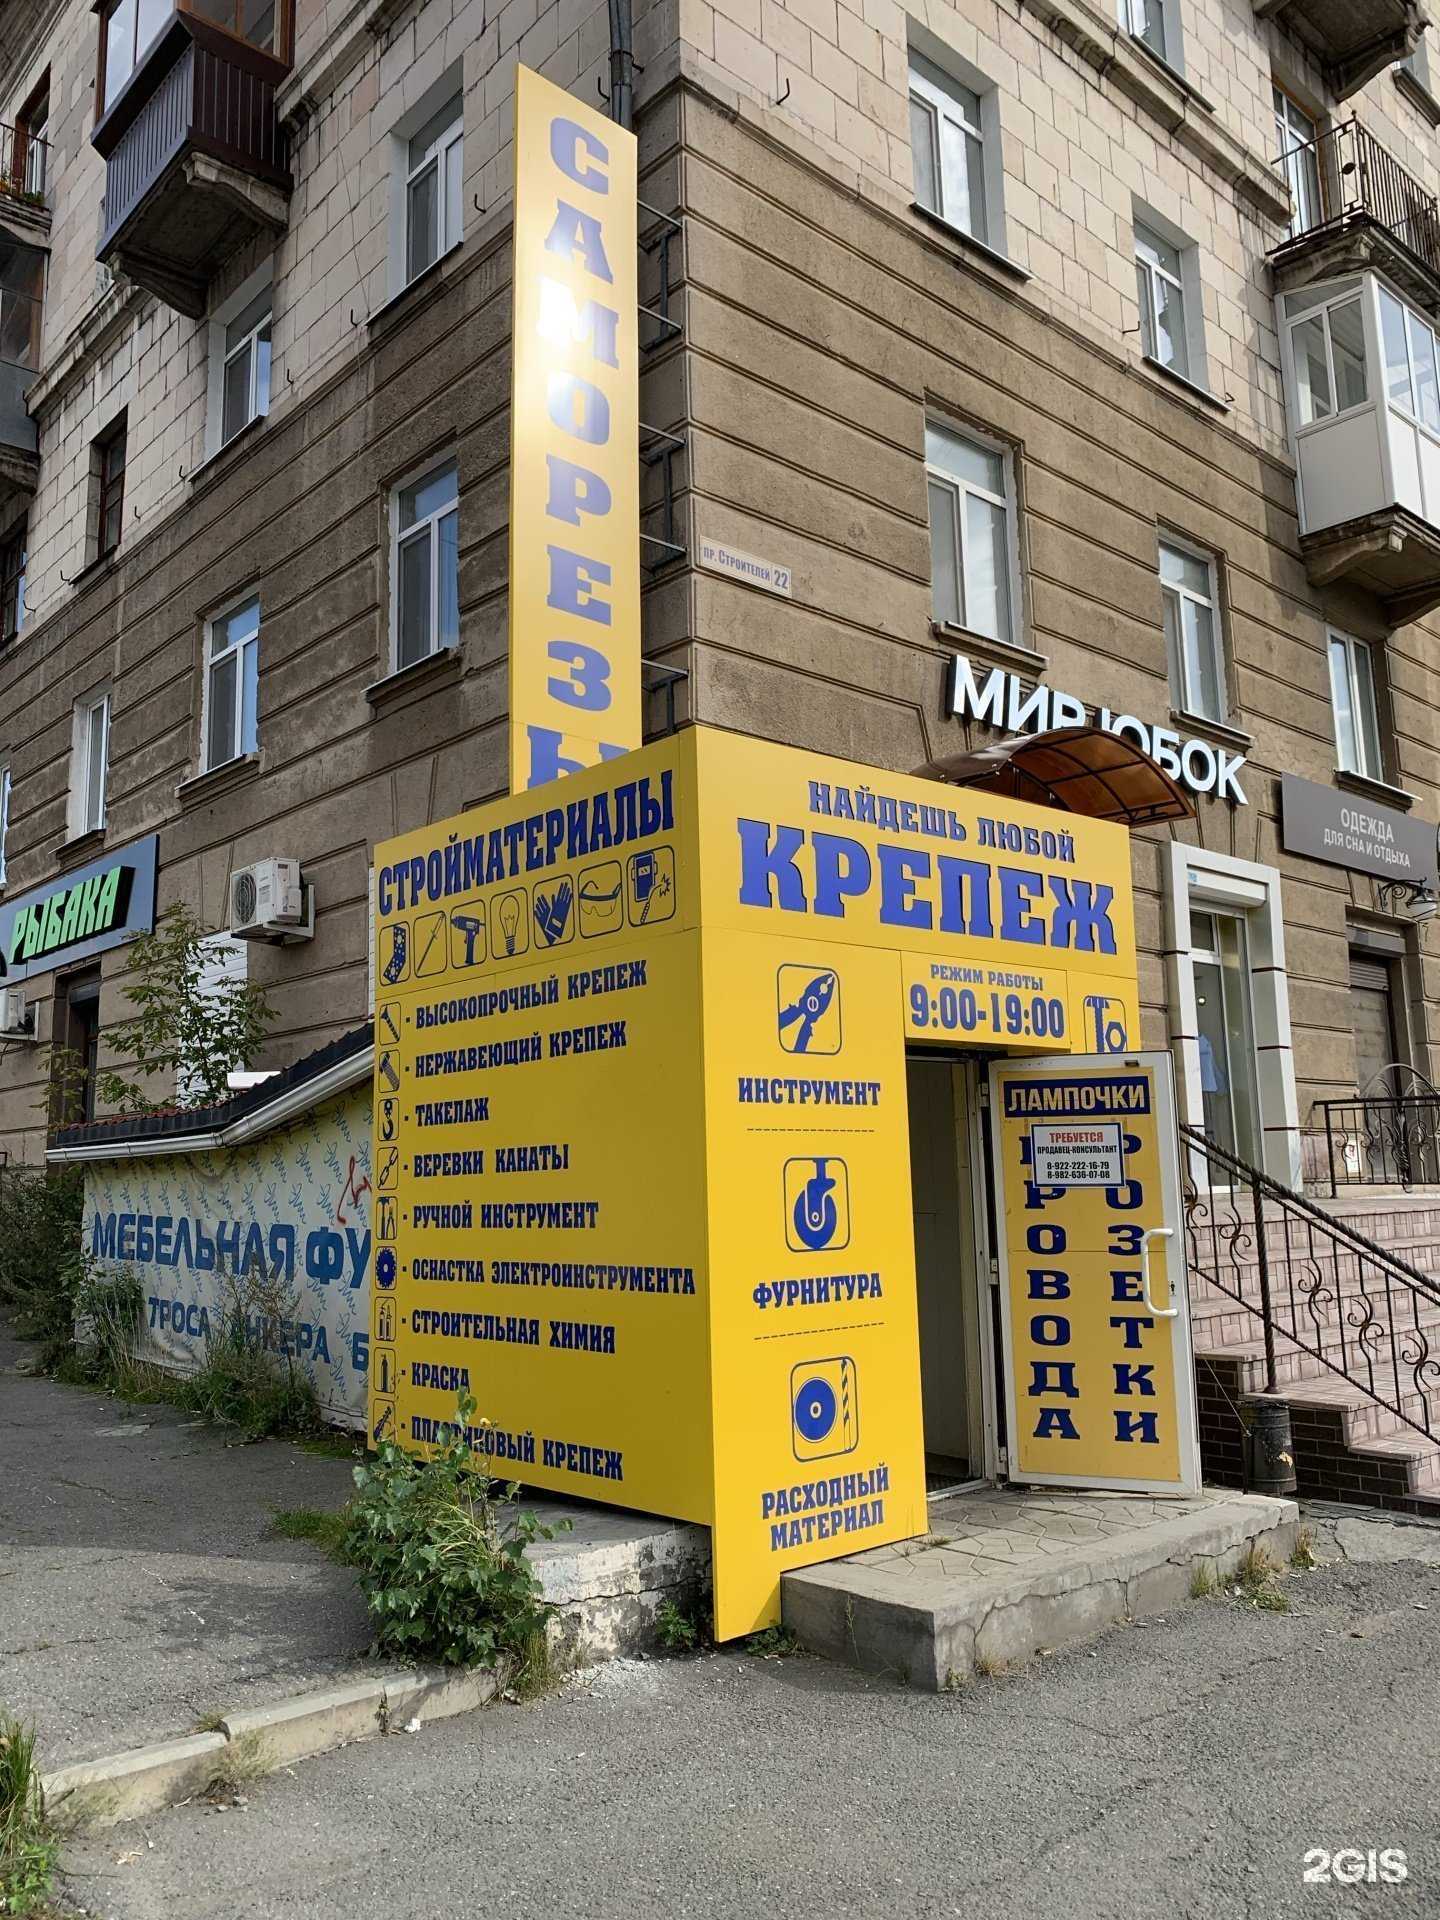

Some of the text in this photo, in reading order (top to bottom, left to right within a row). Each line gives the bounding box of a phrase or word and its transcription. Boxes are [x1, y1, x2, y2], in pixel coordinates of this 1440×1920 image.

[774, 569, 789, 589] 22
[950, 654, 1248, 806] МИР ЮБОК
[808, 781, 1075, 863] НАЙДЕШЬ ЛЮБОЙ
[1341, 808, 1394, 843] ОДЕЖДА
[379, 770, 674, 916] СТРОЙМАТЕРИАЛЫ
[1324, 828, 1411, 867] ДЛЯ СНА И ОТДЫХА
[737, 817, 1118, 956] КРЕПЕЖ
[9, 866, 124, 965] РЫБАКА
[416, 960, 647, 1029] ВЫСОКОПРОЧНЫЙ КРЕПЕЖ
[930, 964, 1044, 991] РЕЖИМ РАБОТЫ
[909, 983, 1065, 1039] 9:00-19:00
[416, 1021, 627, 1078] НЕРЖАВЕЮЩИЙ КРЕПЕЖ
[738, 1077, 881, 1106] ИНСТРУМЕНТ
[1008, 1084, 1145, 1112] ЛАМПОЧКИ
[415, 1097, 489, 1127] ТАКЕЛАЖ
[1037, 1145, 1117, 1155] ПРОДАВЕЦ-КОНСУЛЬТАНТ
[1049, 1132, 1104, 1144] ТРЕБУЕТСЯ
[413, 1143, 569, 1178] ВЕРЕВКИ КАНАТЫ
[413, 1200, 599, 1229] РУЧНОЙ ИНСТРУМЕНТ
[92, 1211, 295, 1282] МЕБЕЛЬНАЯ
[412, 1258, 696, 1294] ОСНАСТКА ЭЛЕКТРОИНСТРУМЕНТА
[753, 1272, 883, 1309] ФУРНИТУРА
[412, 1309, 616, 1354] СТРОИТЕЛЬНАЯ ХИМИЯ
[411, 1361, 470, 1394] КРАСКА
[411, 1416, 624, 1481] ПЛАТИКОВЫЙ КРЕПЕЖ
[761, 1462, 890, 1520] РАСХОДНЫЙ
[771, 1499, 885, 1552] МАТЕРИАЛ
